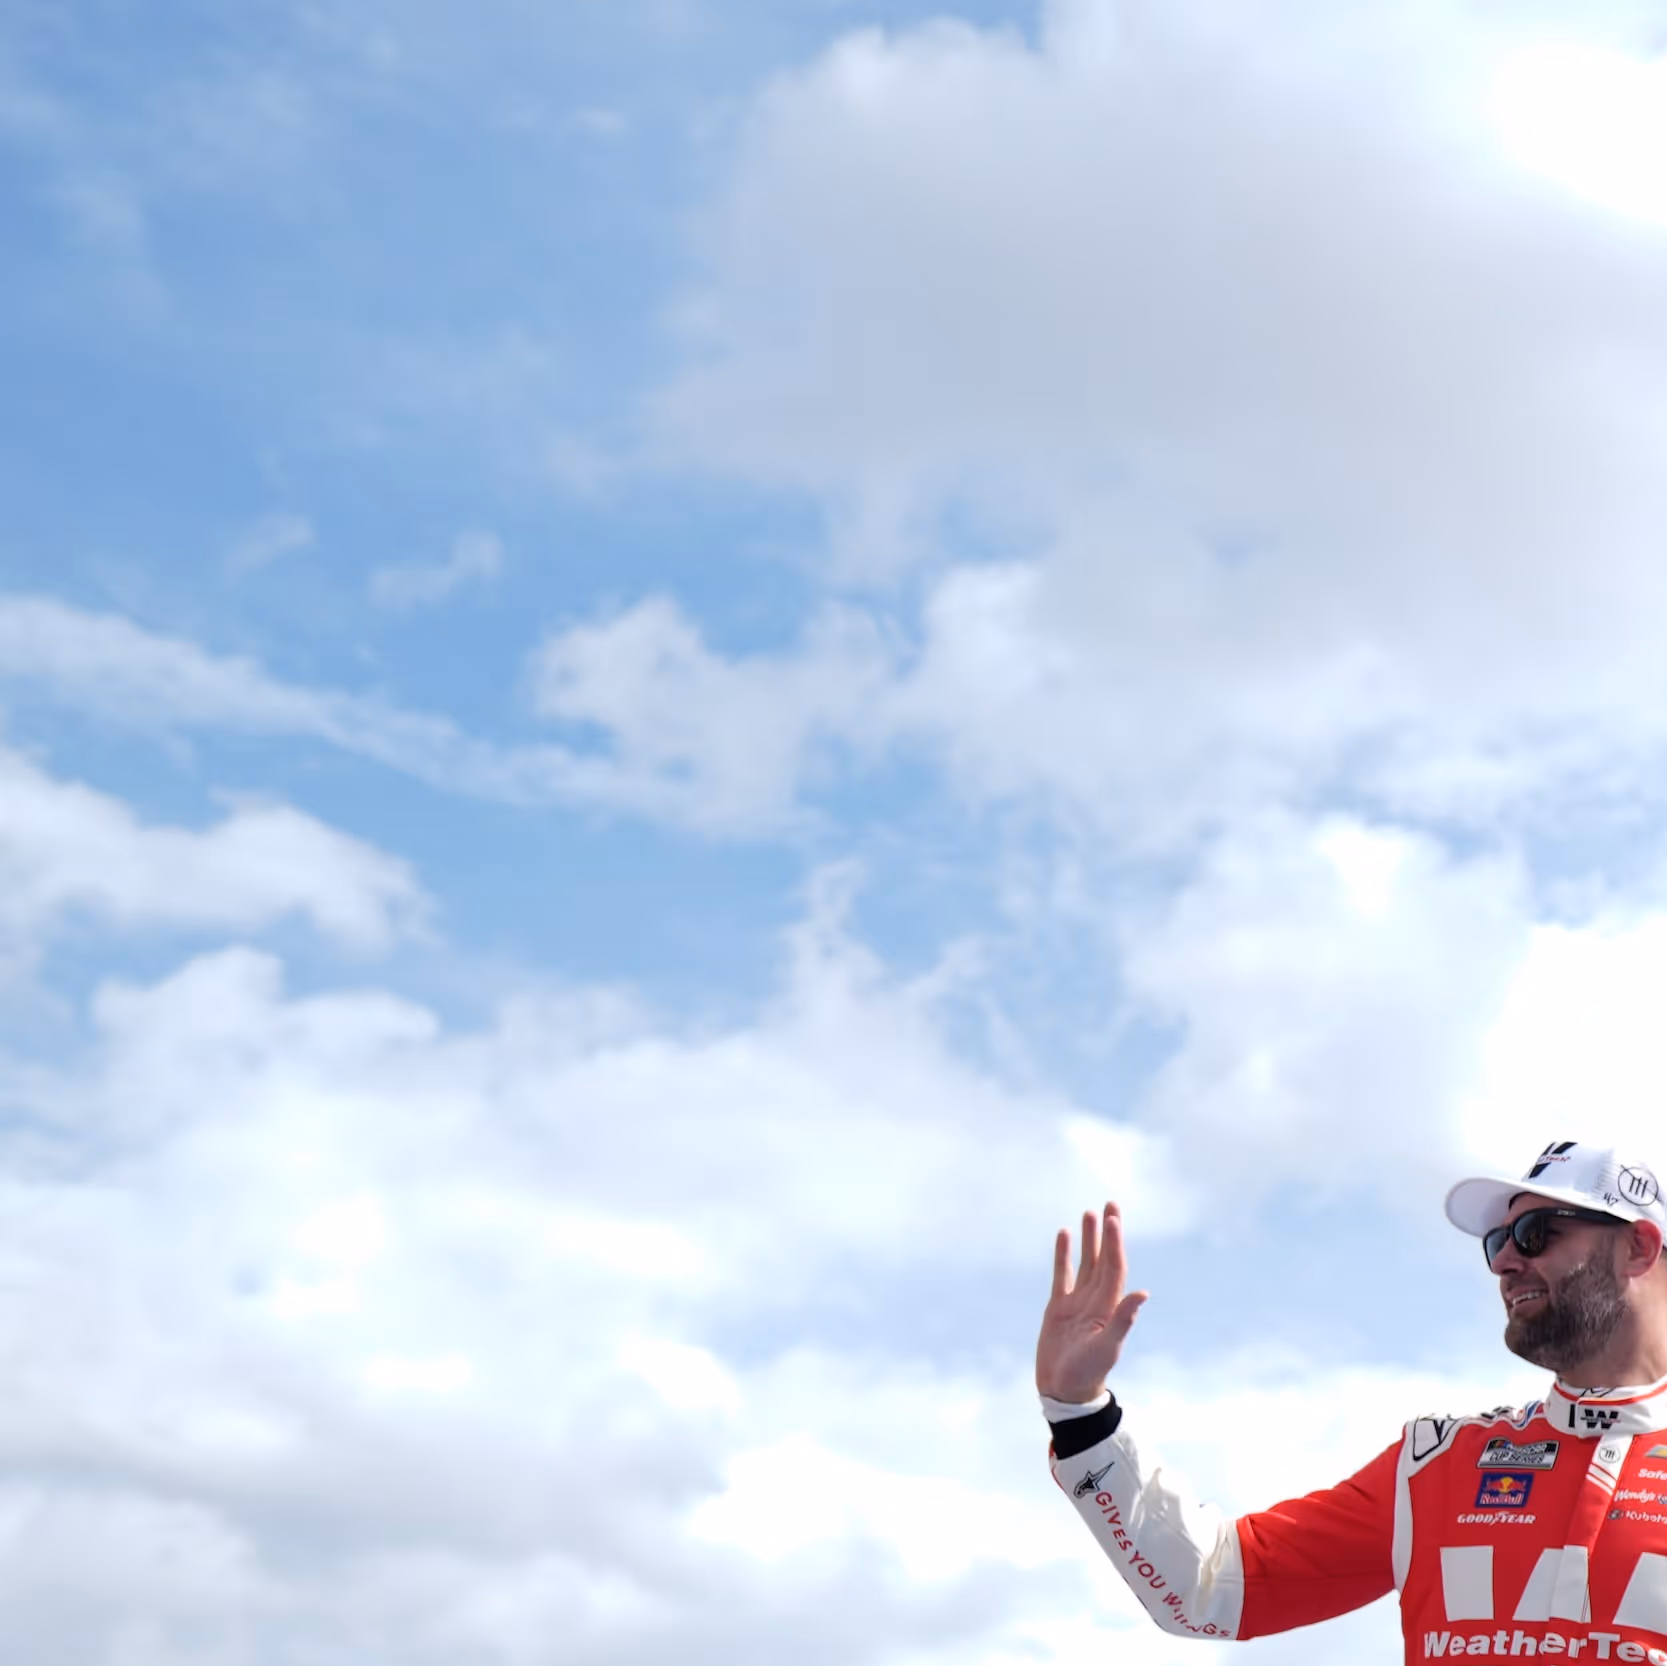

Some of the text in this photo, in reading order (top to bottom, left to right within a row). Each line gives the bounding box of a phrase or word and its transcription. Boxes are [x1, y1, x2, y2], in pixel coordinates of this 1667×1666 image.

[1489, 1451, 1545, 1464] CUP SERIES
[1457, 1510, 1536, 1525] GOODYEAR
[1095, 1491, 1133, 1552] GIVES
[1128, 1550, 1167, 1590] YOU
